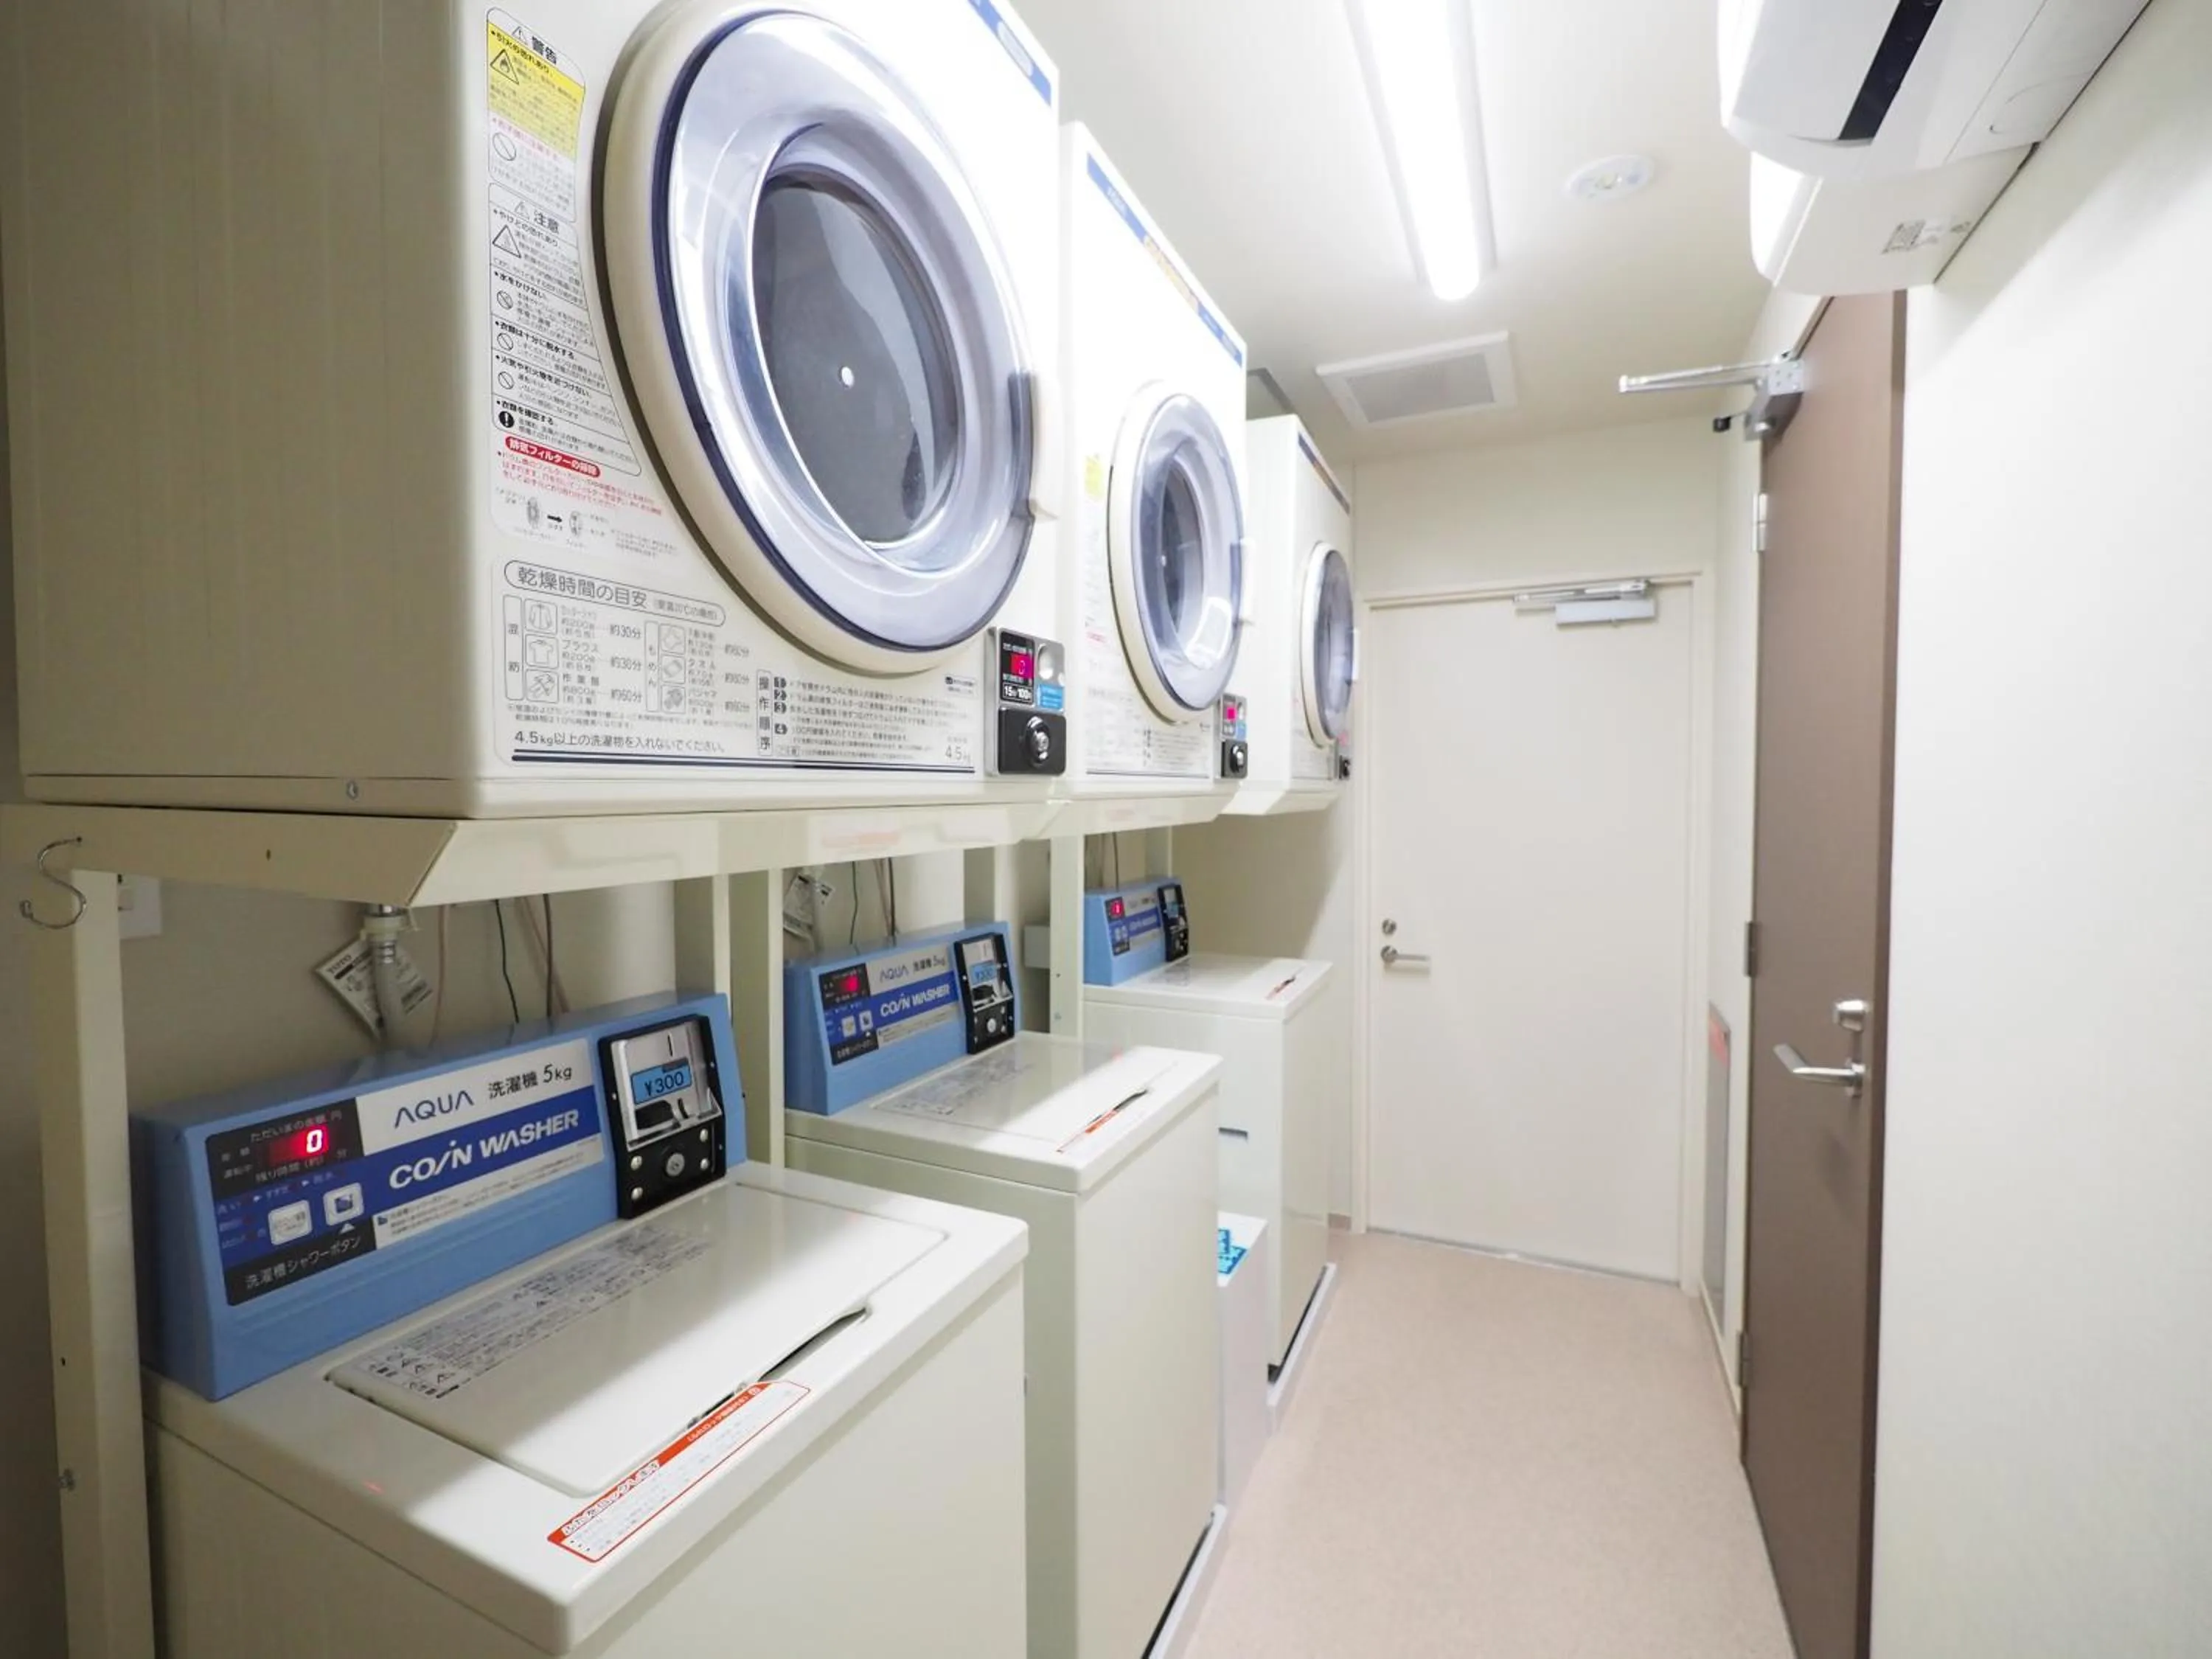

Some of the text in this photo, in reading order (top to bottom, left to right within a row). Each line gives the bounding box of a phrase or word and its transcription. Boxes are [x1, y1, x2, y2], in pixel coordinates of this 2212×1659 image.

[534, 209, 560, 234] 注意
[518, 566, 647, 609] 乾燥時間の目安
[879, 965, 910, 984] AQUA
[880, 993, 911, 1018] COIN
[911, 983, 951, 1006] WASHER
[394, 1063, 573, 1129] AQUA 洗濯機 5kg
[644, 1071, 684, 1096] ¥300
[306, 1129, 323, 1153] 0
[389, 1139, 473, 1189] COIN
[479, 1109, 580, 1159] WASHER
[245, 1236, 361, 1289] 洗濯槽シャワーボタン
